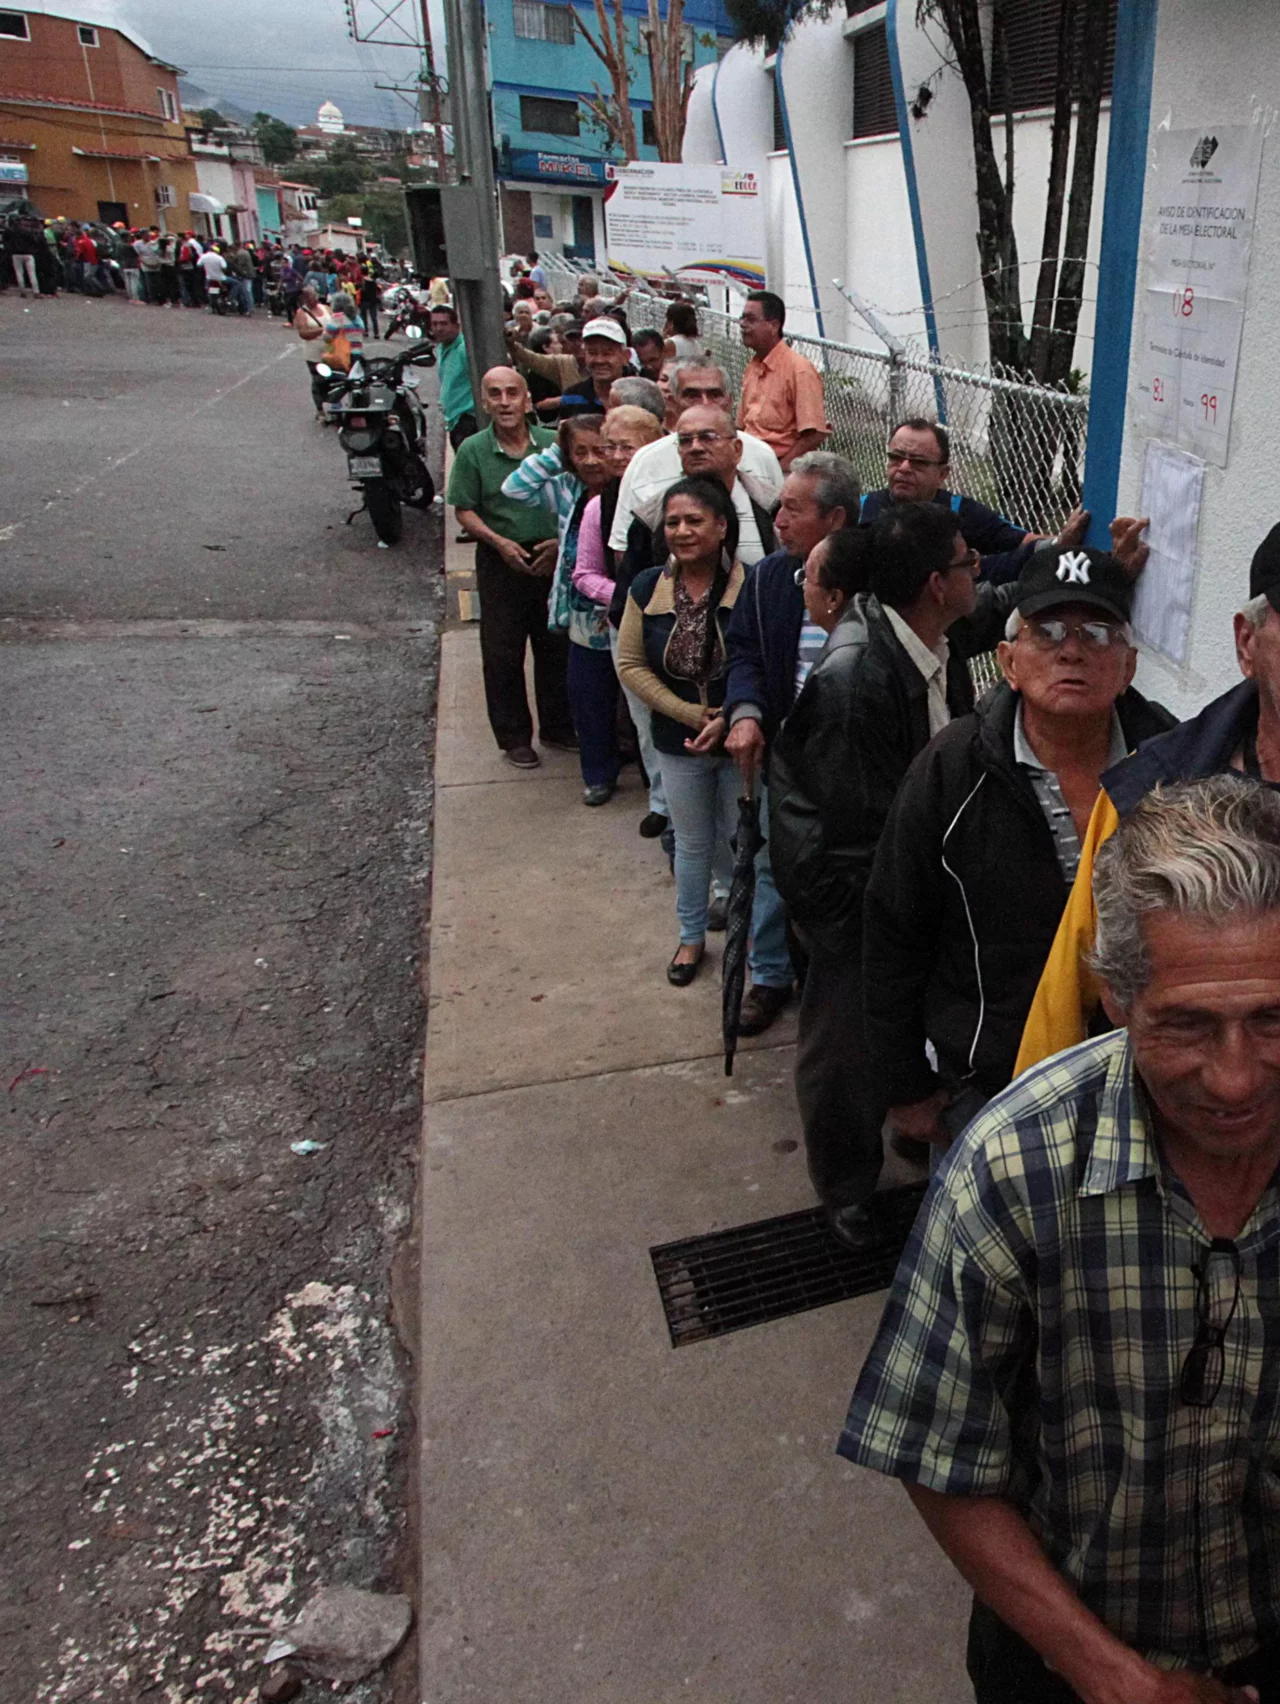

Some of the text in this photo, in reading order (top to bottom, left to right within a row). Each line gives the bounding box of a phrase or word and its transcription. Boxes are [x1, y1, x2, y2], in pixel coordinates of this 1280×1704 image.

[539, 160, 591, 176] MIKEL
[1194, 224, 1237, 239] ELECTORAL
[1200, 393, 1218, 425] 99
[1055, 550, 1092, 585] NY
